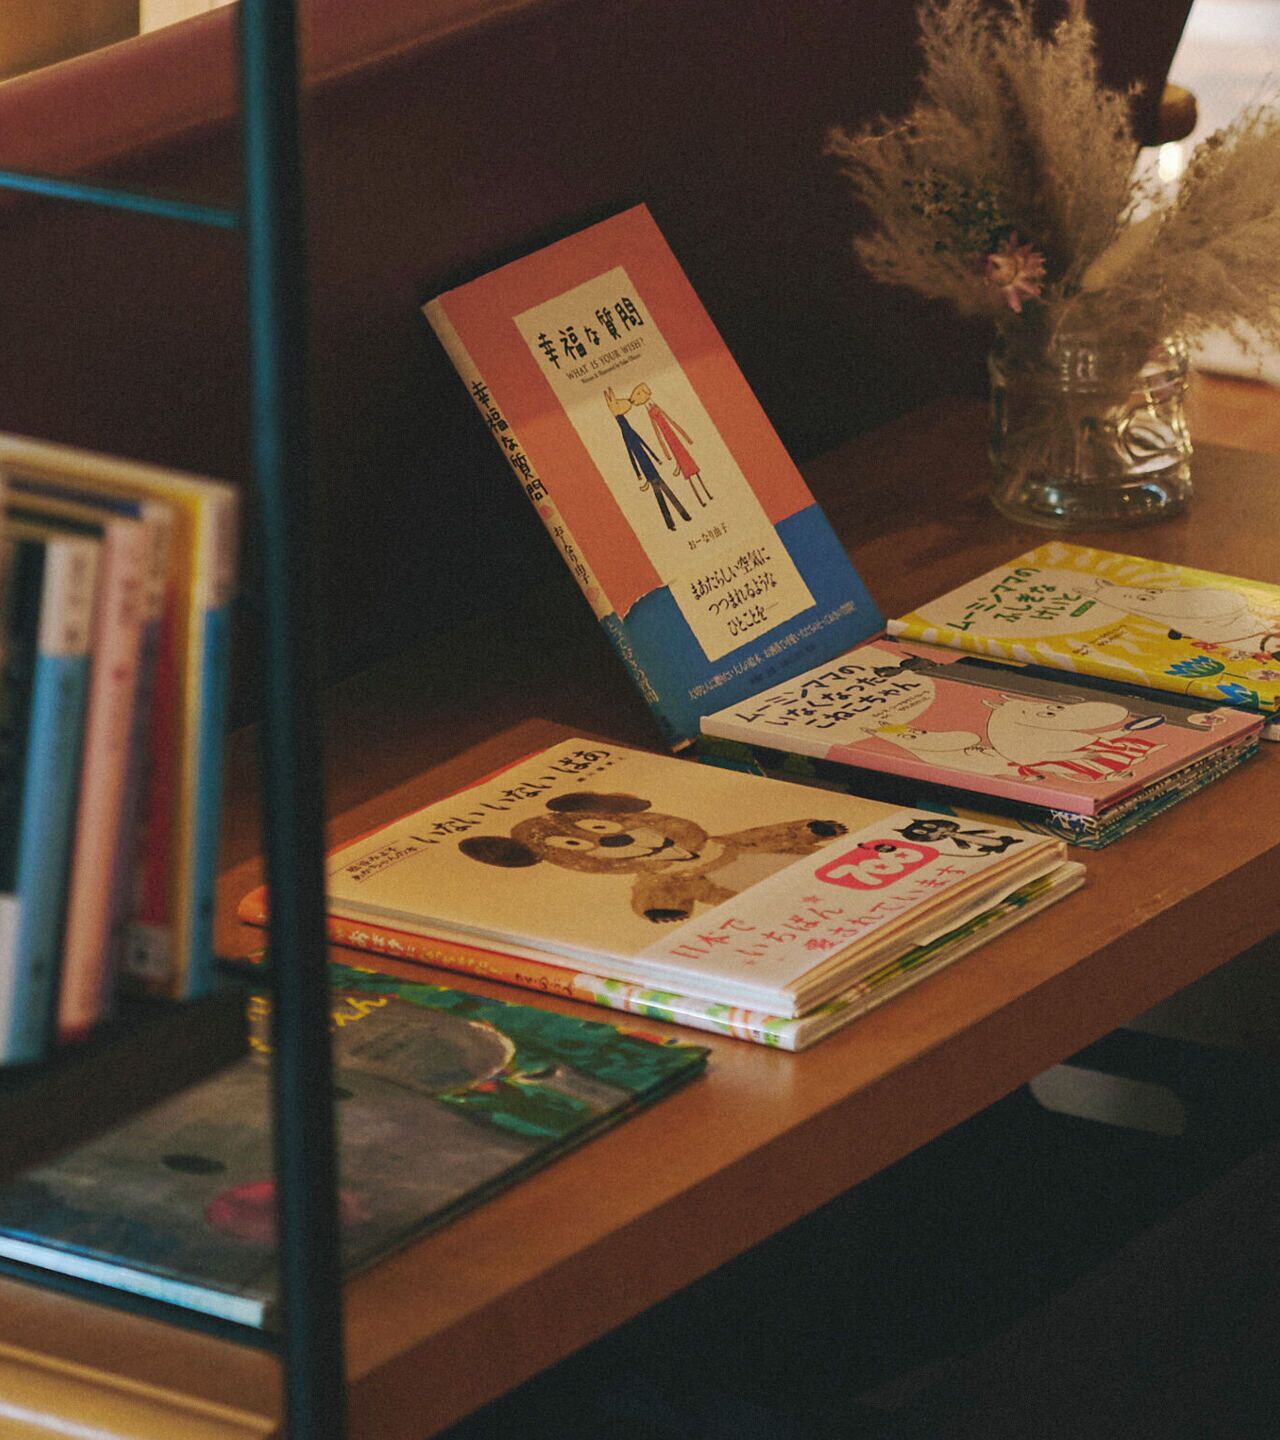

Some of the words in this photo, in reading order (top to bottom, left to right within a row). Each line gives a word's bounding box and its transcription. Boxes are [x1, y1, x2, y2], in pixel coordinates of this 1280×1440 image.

[537, 297, 645, 370] 幸福な質問
[566, 364, 589, 381] WHAT
[600, 347, 621, 366] YOUR
[471, 380, 549, 502] 幸福な質問
[690, 546, 772, 601] まあたらしい空気に
[708, 571, 778, 615] つつまれるような
[946, 567, 1041, 631] ムーミンママの
[735, 664, 866, 723] ムーミンママの
[765, 676, 888, 726] いなくなった
[805, 682, 922, 728] こねこちゃん
[735, 907, 844, 956] いちばん
[803, 864, 967, 952] 愛されています
[669, 917, 757, 960] 日本で
